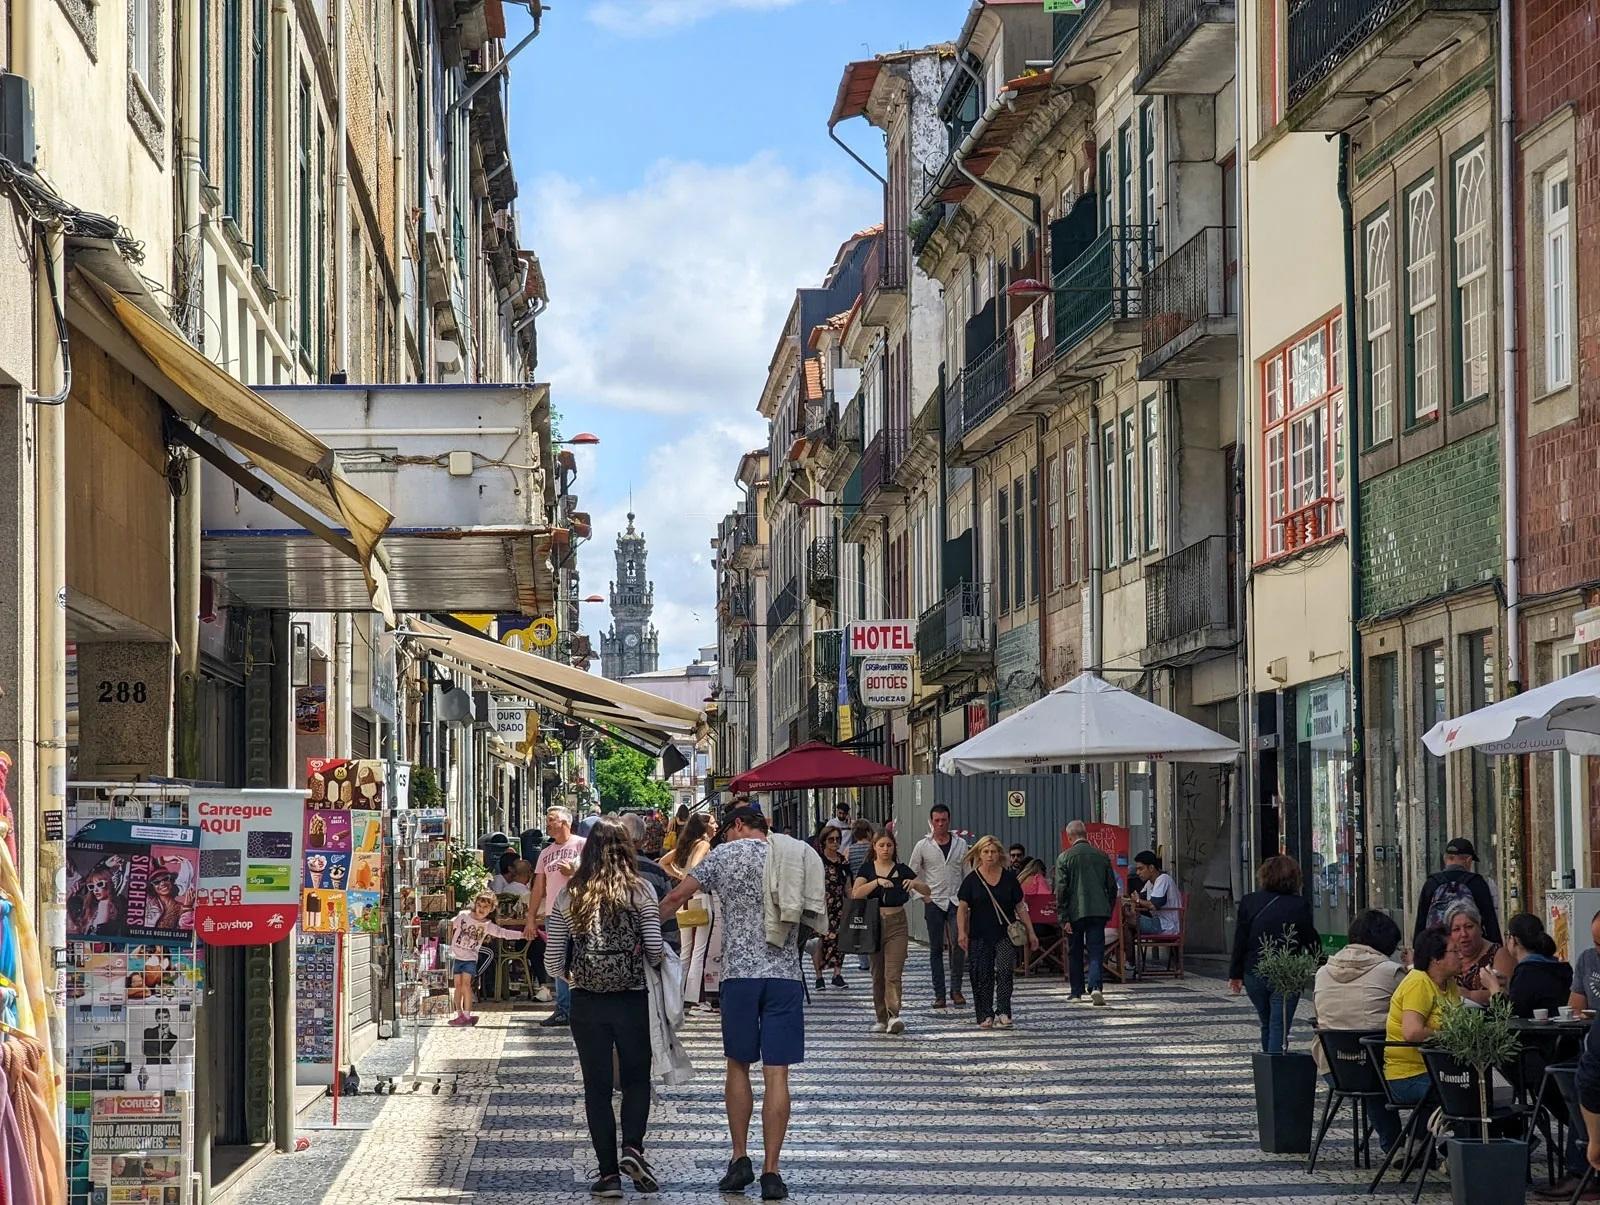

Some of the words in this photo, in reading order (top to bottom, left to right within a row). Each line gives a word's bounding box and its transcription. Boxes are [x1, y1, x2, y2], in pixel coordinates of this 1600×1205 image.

[853, 626, 913, 649] HOTEL
[866, 674, 907, 689] BOTÕES
[98, 681, 147, 703] 288
[497, 712, 521, 720] OURO
[198, 802, 272, 819] Carregue
[200, 819, 240, 835] AQUI
[1087, 832, 1116, 840] TRELLA
[126, 855, 149, 926] SKECHERS
[216, 919, 254, 931] payshop
[120, 1098, 160, 1108] CORREIO
[93, 1124, 114, 1137] NOVO
[115, 1124, 152, 1137] AUMENTO
[152, 1124, 180, 1136] BRUTAL
[93, 1137, 109, 1150] DOS
[109, 1136, 164, 1150] COMBUSTÍVEIS
